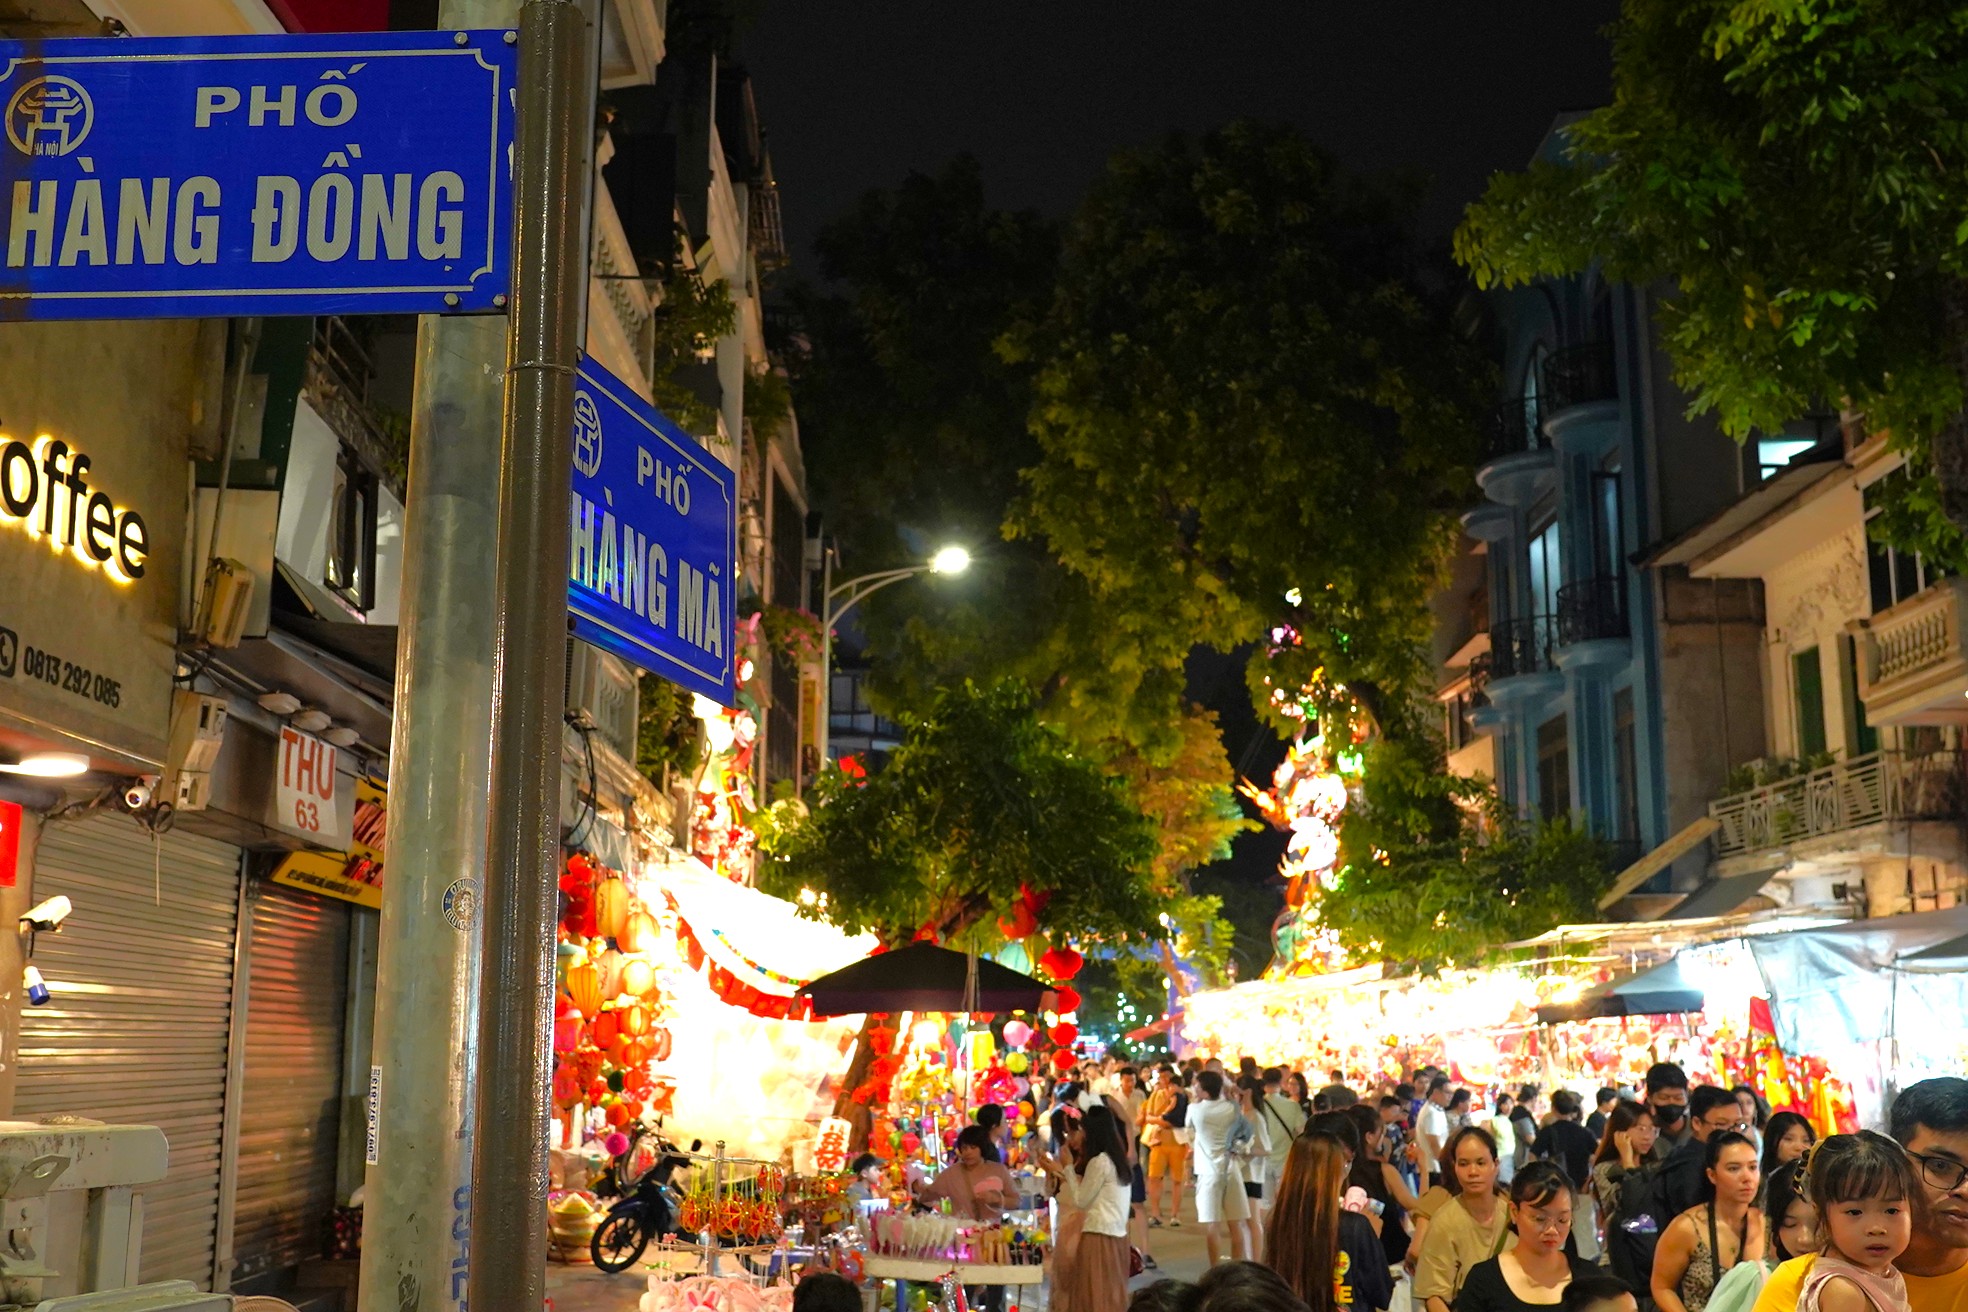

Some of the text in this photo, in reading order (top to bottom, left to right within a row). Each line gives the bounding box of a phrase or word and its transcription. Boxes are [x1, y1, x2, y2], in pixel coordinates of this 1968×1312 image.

[195, 63, 367, 128] PHỐ
[7, 144, 465, 267] HÀNG ĐỒNG
[0, 440, 148, 579] offee
[637, 444, 693, 517] PHỐ
[570, 486, 723, 660] HÀNG MÃ
[24, 646, 121, 709] 0813 292 085
[283, 728, 336, 801] THU
[295, 798, 319, 832] 63
